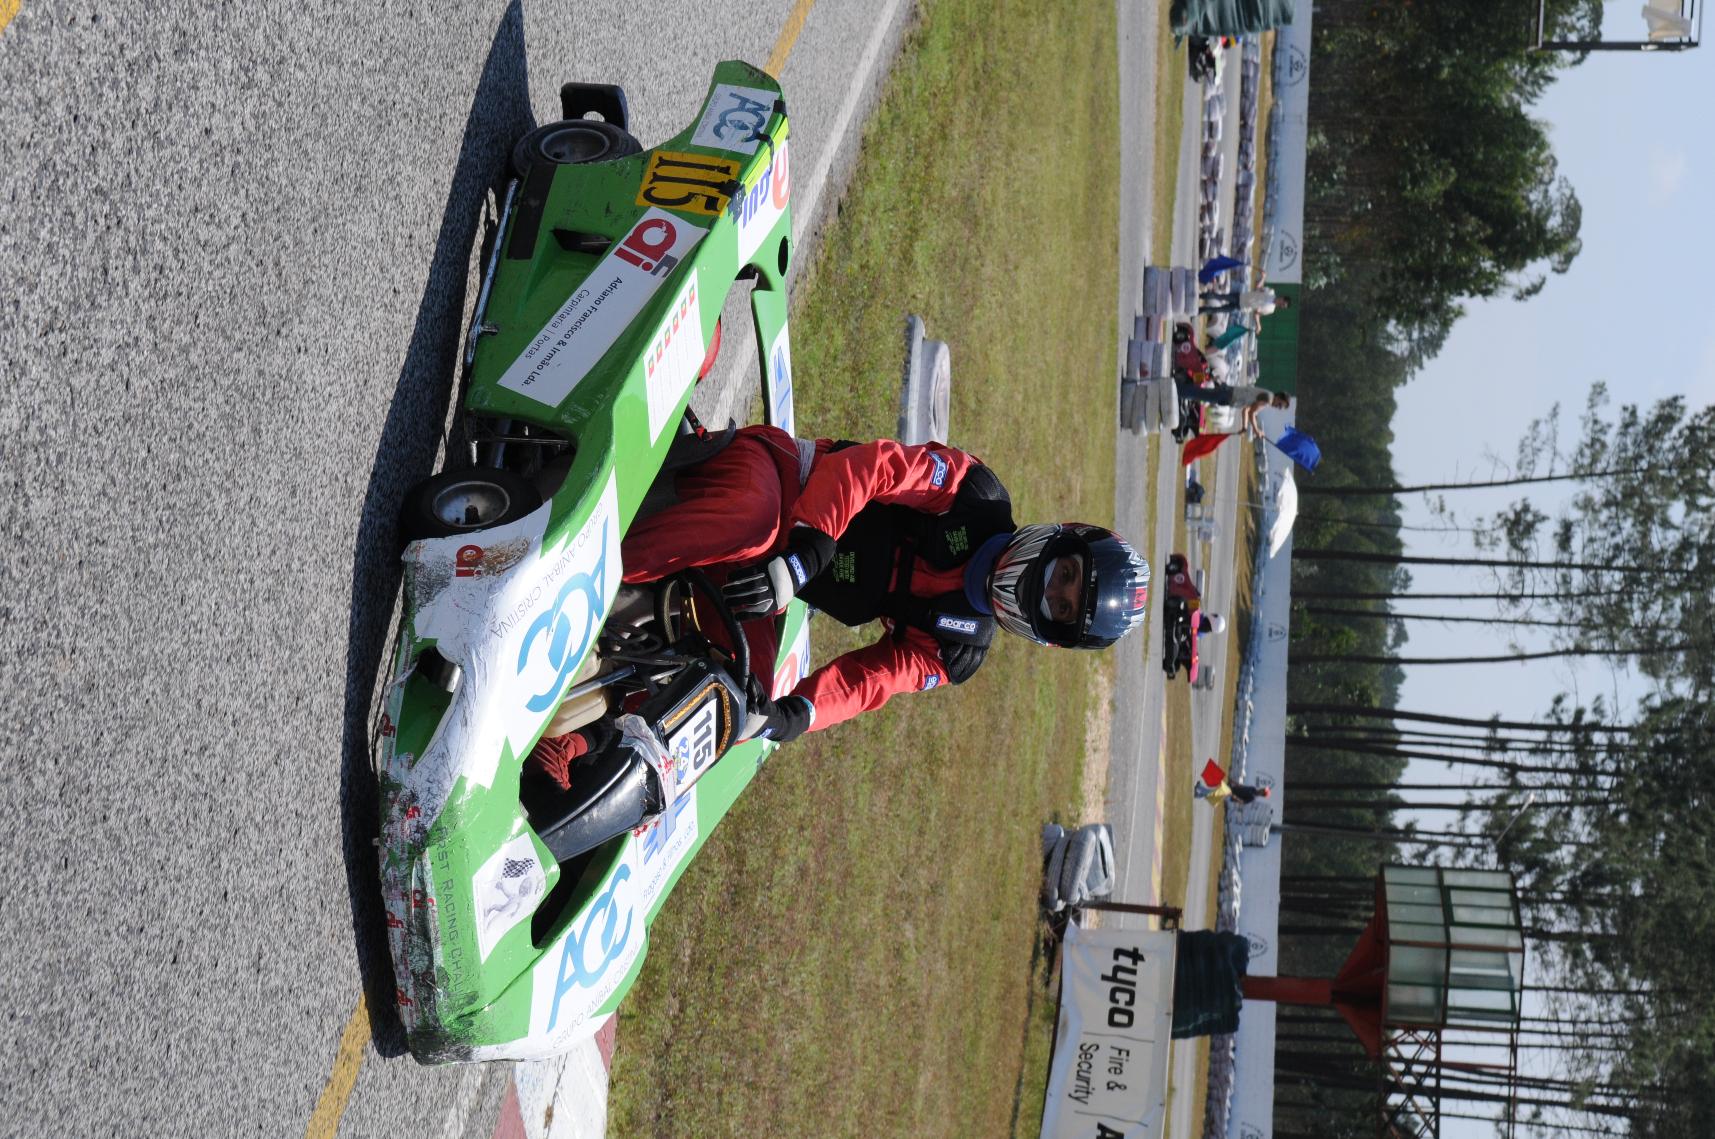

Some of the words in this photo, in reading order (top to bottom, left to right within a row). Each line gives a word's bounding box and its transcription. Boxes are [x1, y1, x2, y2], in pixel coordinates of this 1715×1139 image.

[643, 156, 732, 212] 115
[594, 277, 623, 306] Adriano
[551, 289, 590, 329] Carpintaria
[564, 306, 598, 340] Francisco
[525, 335, 550, 360] Portas
[536, 347, 561, 370] Irmão
[521, 370, 541, 386] Lda.
[490, 586, 542, 638] CRISTINA
[694, 710, 712, 770] 115
[1101, 947, 1145, 1028] tyco
[1068, 1042, 1100, 1106] Security
[1108, 1046, 1130, 1074] Fire
[1106, 1081, 1127, 1091] &
